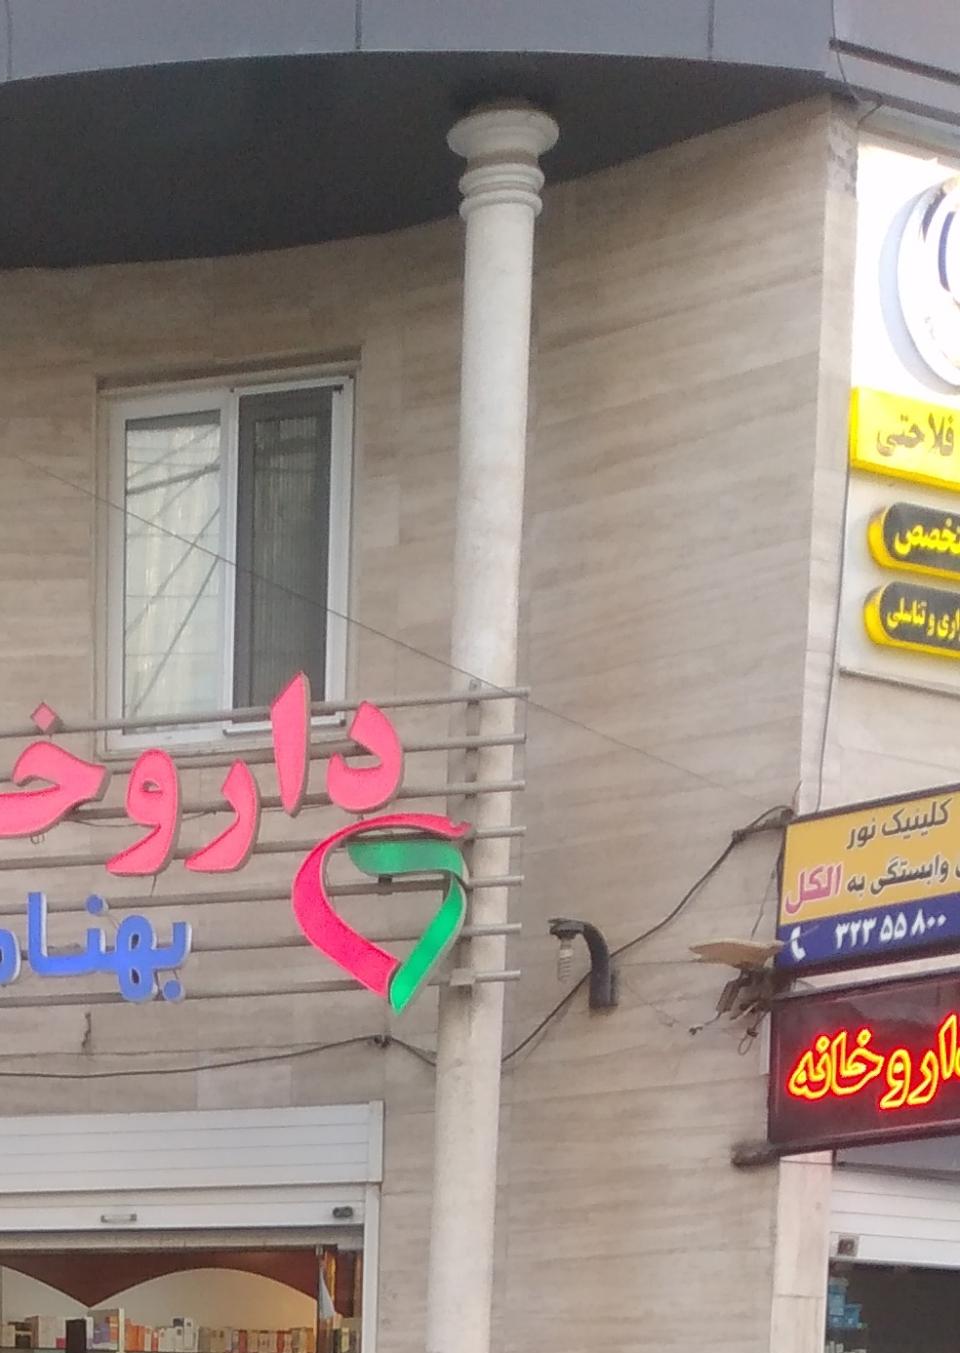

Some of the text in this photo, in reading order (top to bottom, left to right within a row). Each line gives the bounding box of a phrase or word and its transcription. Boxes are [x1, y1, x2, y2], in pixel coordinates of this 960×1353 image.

[876, 411, 955, 457] فلاحتی
[846, 798, 953, 850] کلینیک نور
[785, 862, 844, 915] الکل
[847, 874, 866, 899] به
[870, 854, 950, 896] وابستگی
[788, 1012, 960, 1110] اروخانه
